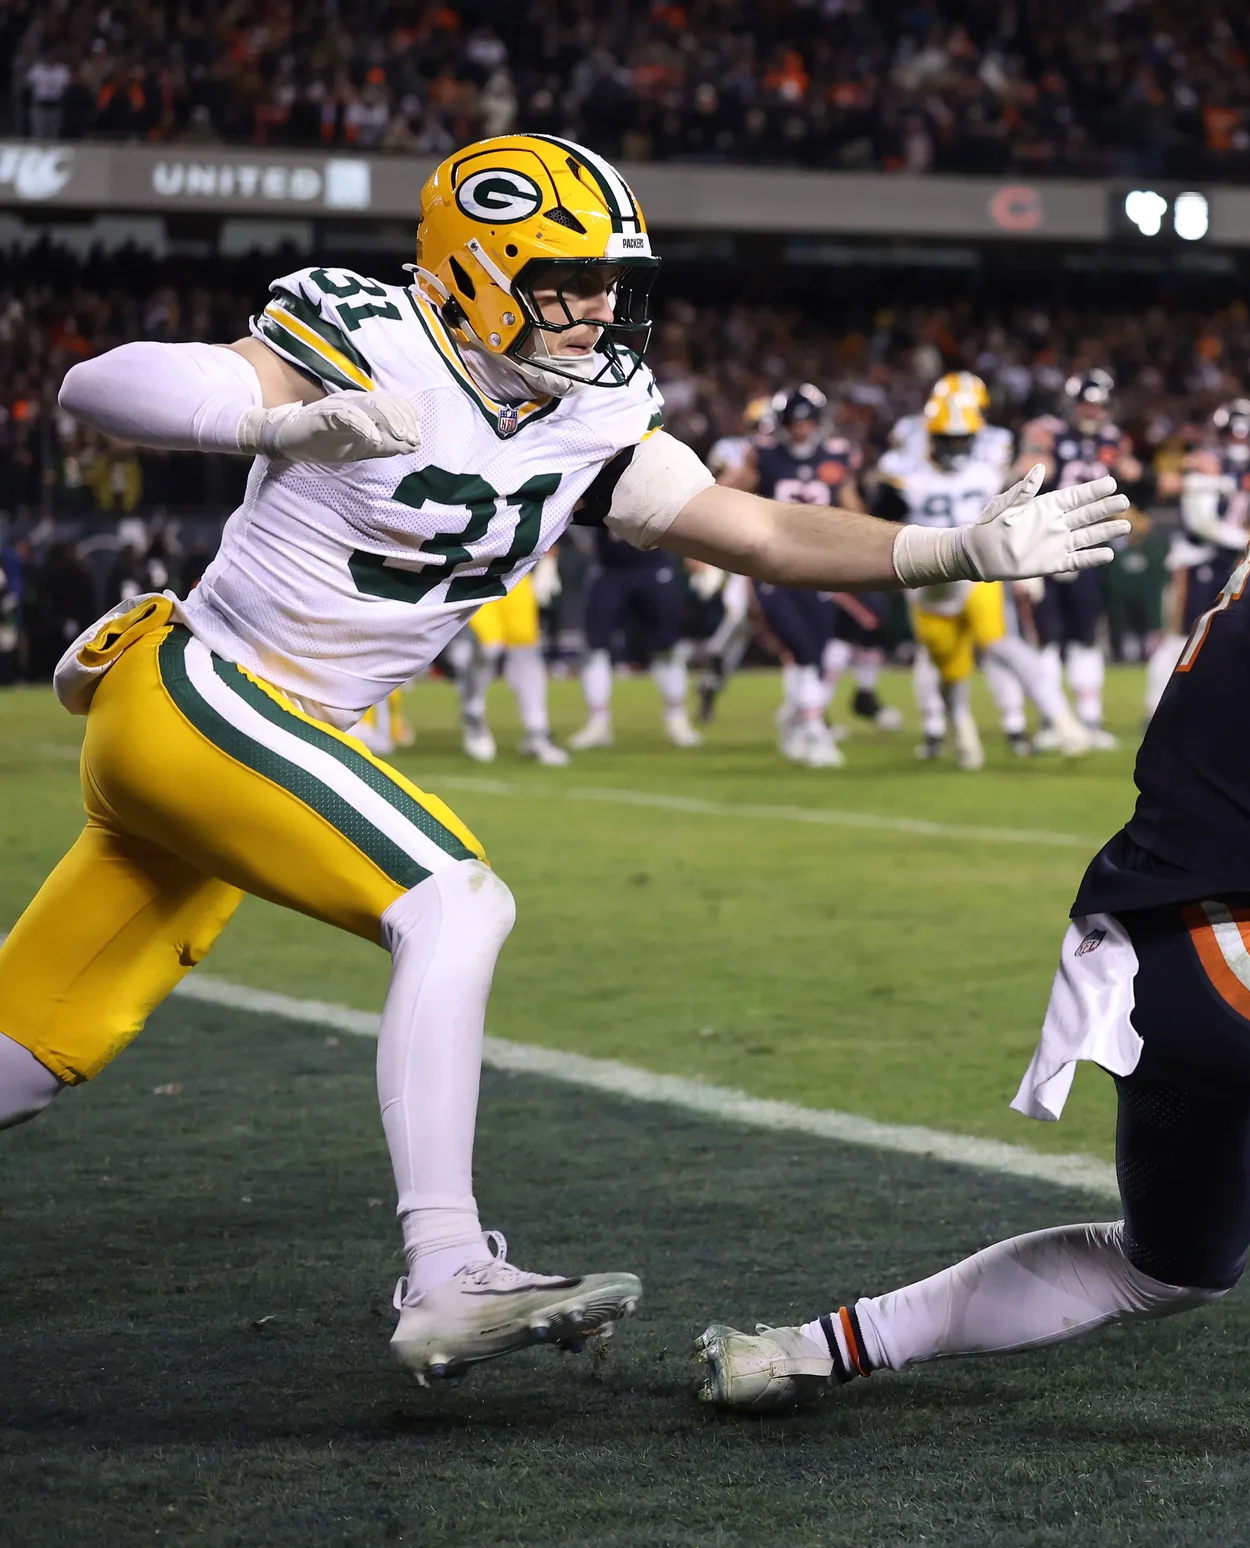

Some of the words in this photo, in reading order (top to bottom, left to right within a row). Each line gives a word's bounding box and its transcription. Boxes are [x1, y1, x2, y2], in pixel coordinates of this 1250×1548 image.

[153, 160, 322, 200] UNITED
[457, 169, 539, 222] G
[622, 238, 644, 249] PACKERS
[308, 268, 403, 332] 31
[500, 418, 517, 431] NFL
[347, 464, 563, 605] 31
